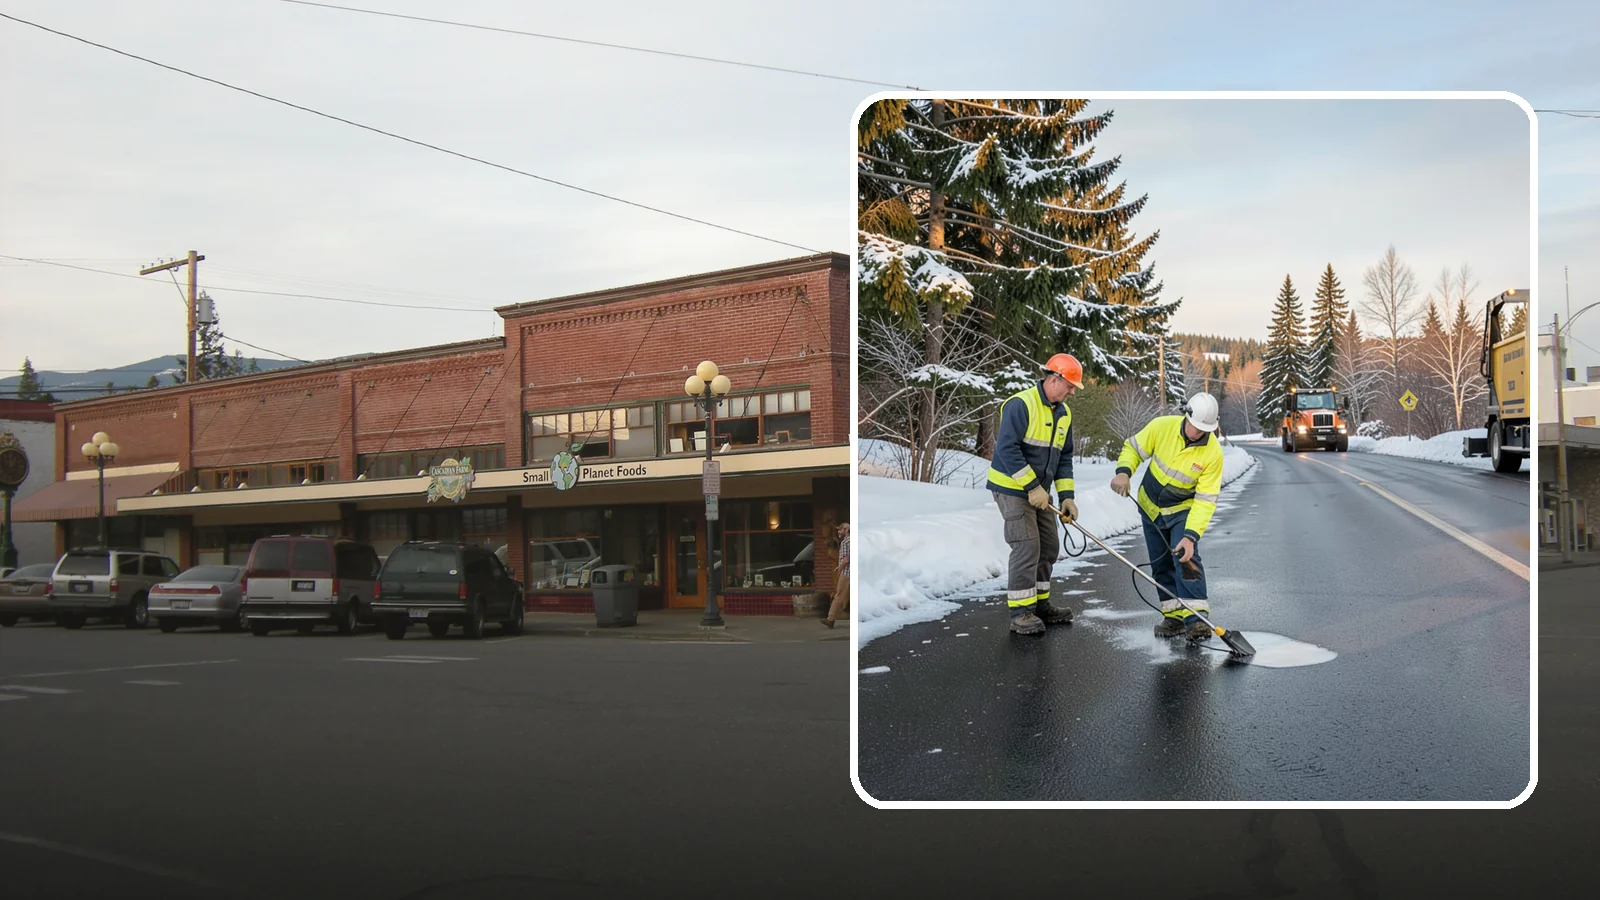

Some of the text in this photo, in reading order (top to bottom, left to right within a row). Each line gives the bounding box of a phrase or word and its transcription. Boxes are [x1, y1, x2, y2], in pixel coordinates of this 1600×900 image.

[523, 464, 646, 483] Small Planet Foods
